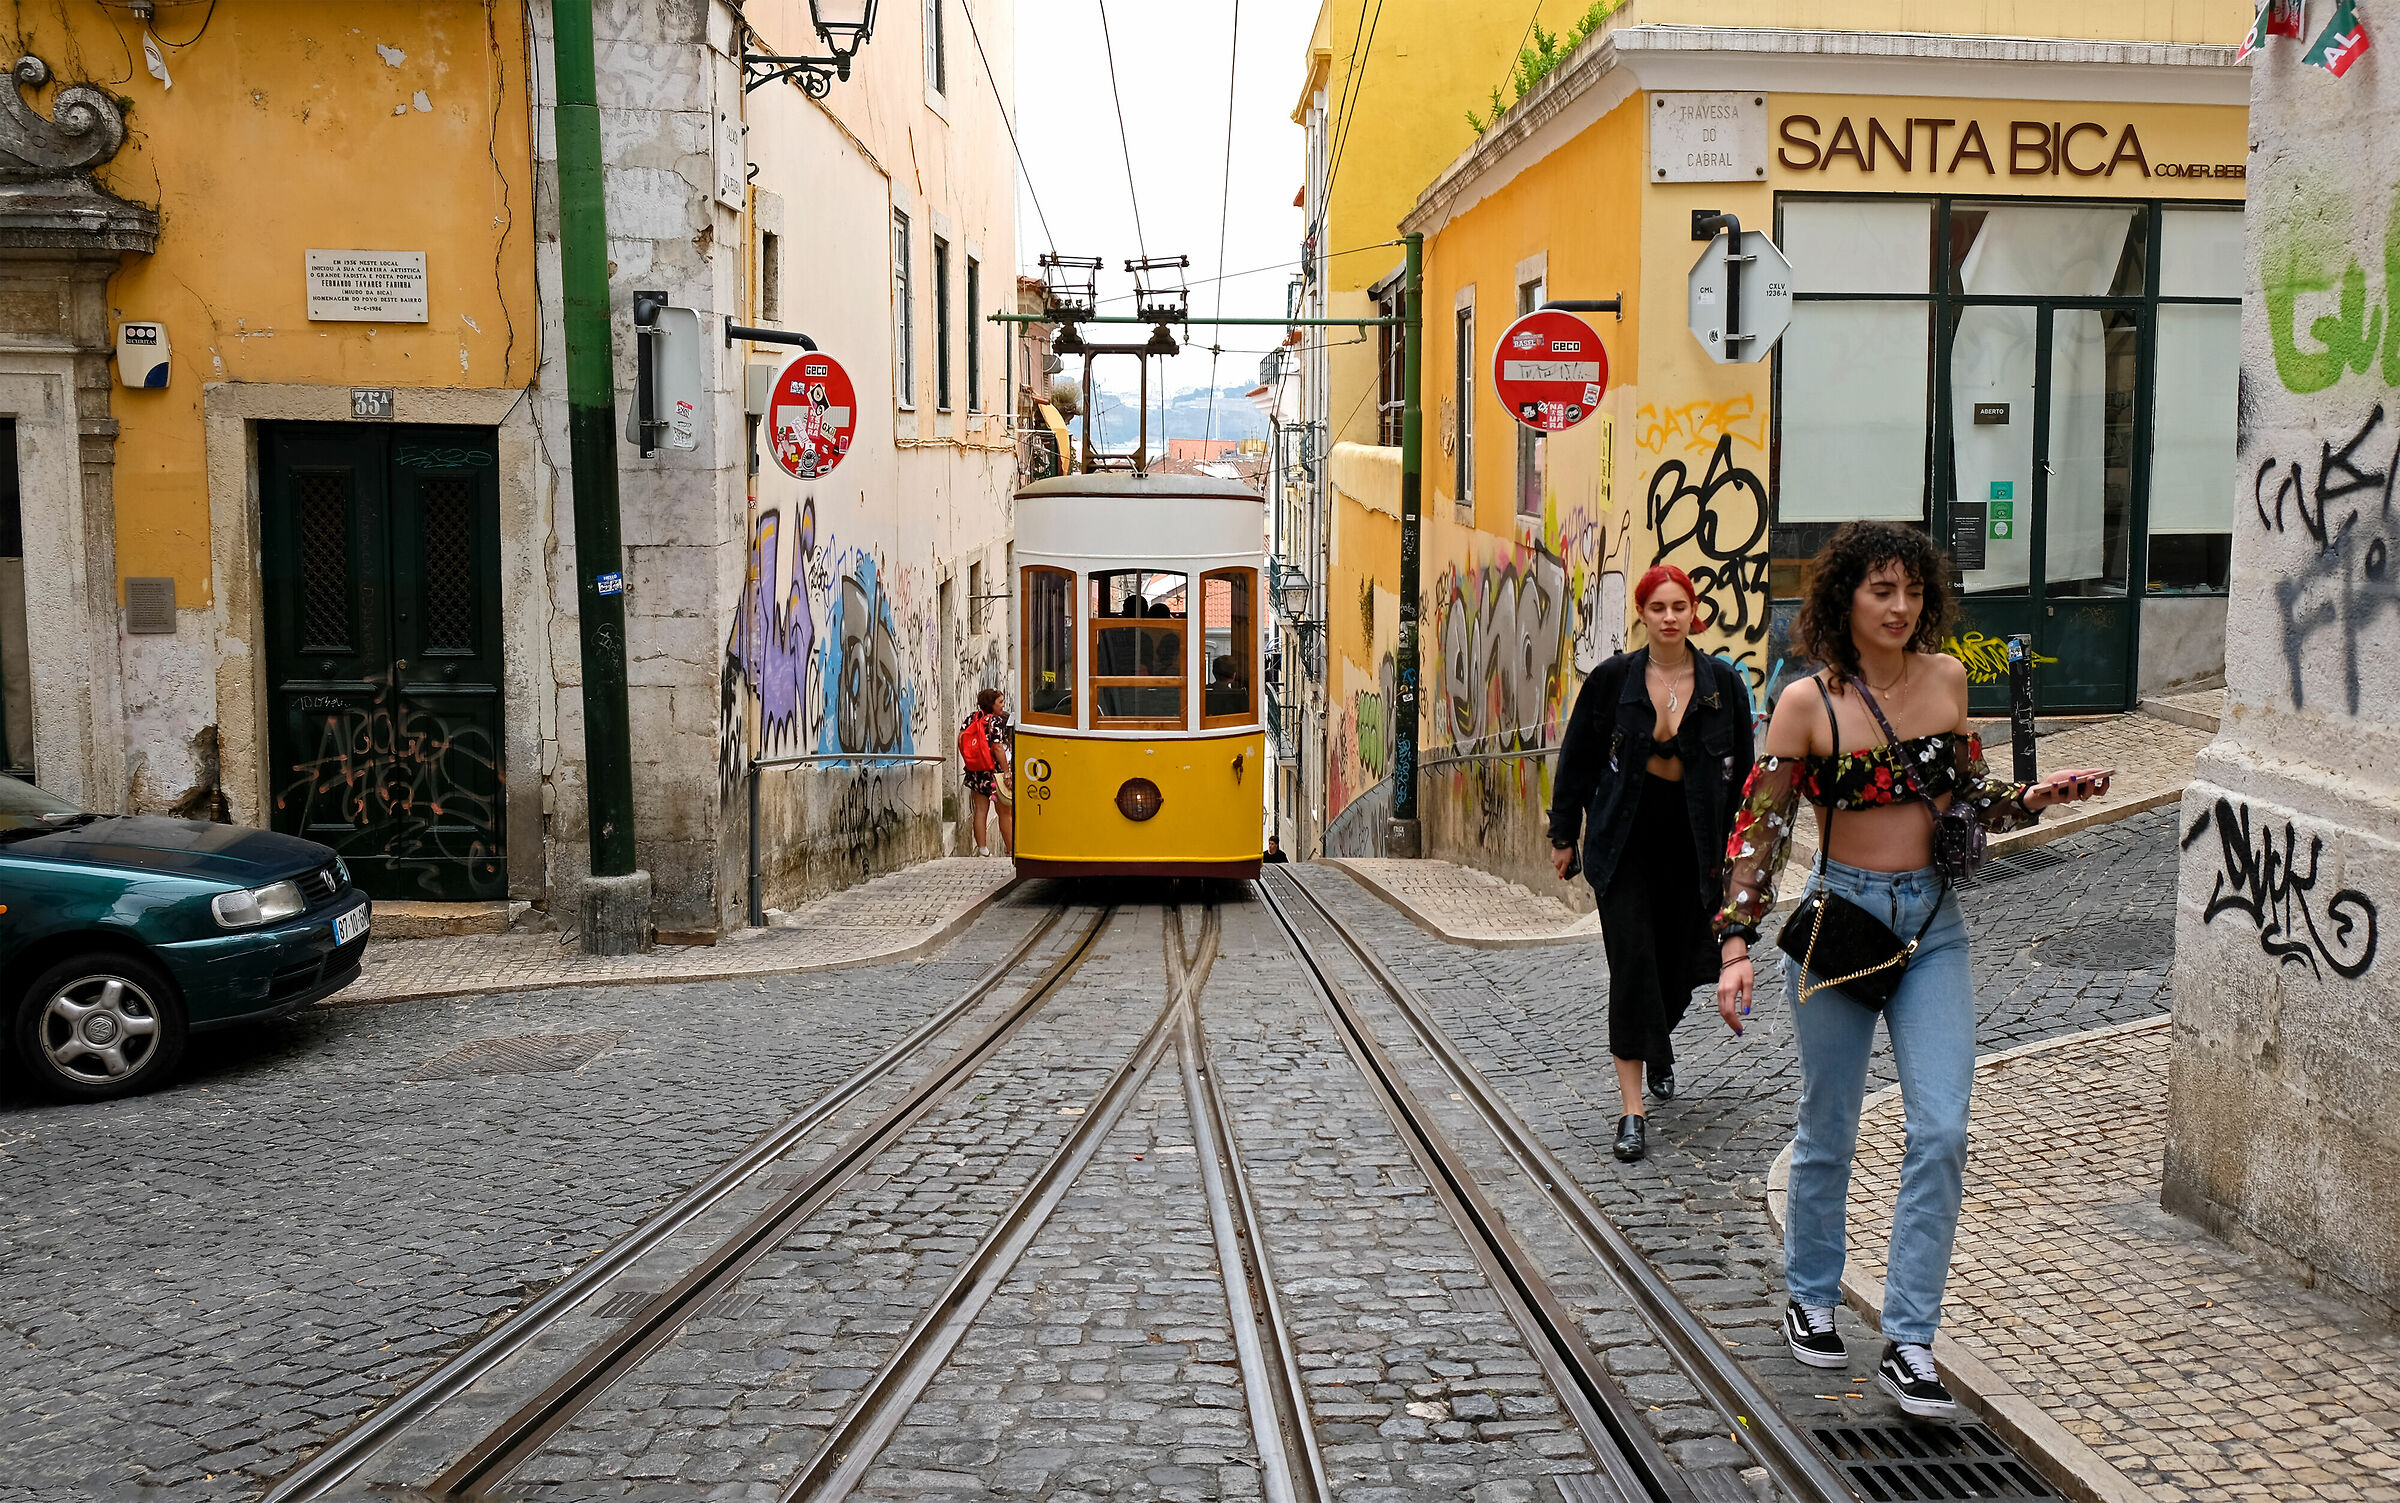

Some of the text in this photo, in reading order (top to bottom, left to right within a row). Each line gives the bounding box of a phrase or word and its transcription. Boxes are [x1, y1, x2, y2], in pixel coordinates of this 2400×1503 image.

[1680, 106, 1739, 120] TRAVESSA
[1702, 128, 1716, 142] DO
[1778, 114, 1996, 175] SANTA
[2010, 121, 2152, 178] BICA
[1687, 153, 1732, 166] CABRAL
[338, 906, 370, 940] 87-10-GM
